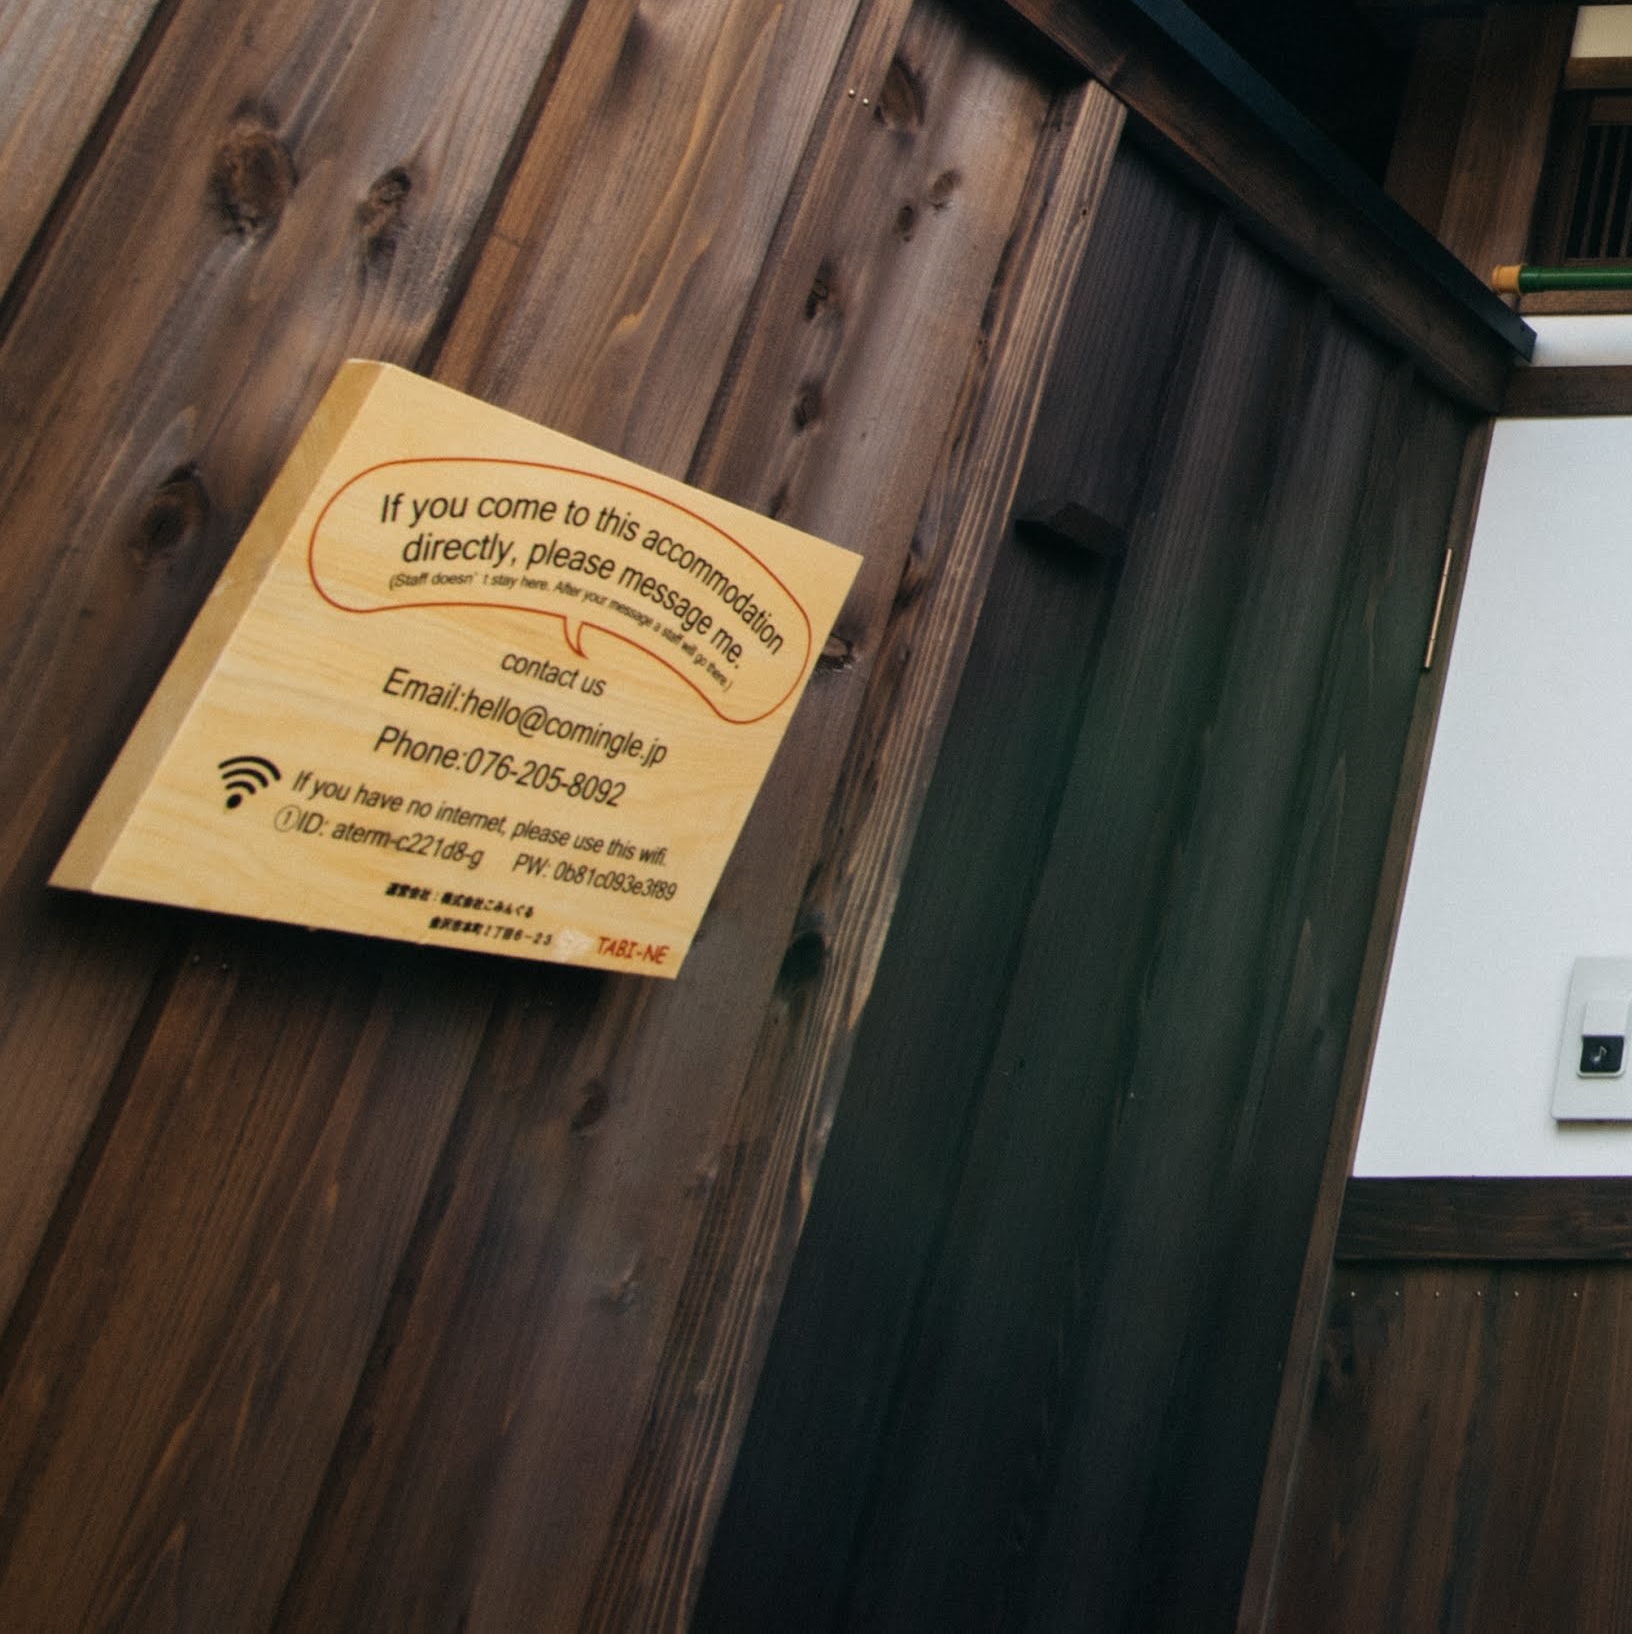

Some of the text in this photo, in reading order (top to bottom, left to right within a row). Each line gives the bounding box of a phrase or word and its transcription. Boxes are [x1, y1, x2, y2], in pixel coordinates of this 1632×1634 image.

[381, 492, 784, 656] If you come to this accommodation
[402, 532, 744, 669] directly, please message me.
[389, 572, 429, 591] (Staff
[491, 574, 518, 590] stay
[553, 580, 582, 597] After
[581, 590, 608, 606] your
[609, 599, 654, 627] message
[653, 622, 662, 633] a
[661, 627, 683, 648] staff
[681, 641, 698, 657] will
[693, 653, 707, 667] go
[382, 666, 668, 768] Email:hello@comingle.jp
[501, 653, 607, 697] contact us
[373, 725, 627, 808] Phone:076-205-8092
[292, 770, 313, 792] If
[308, 779, 352, 801] you
[353, 784, 404, 813] have
[406, 800, 433, 818] no
[435, 801, 507, 837] internet,
[511, 820, 571, 846] please
[573, 835, 604, 853] use
[607, 839, 637, 860] this
[512, 852, 552, 879] PW:
[597, 935, 670, 965] TABI-NE
